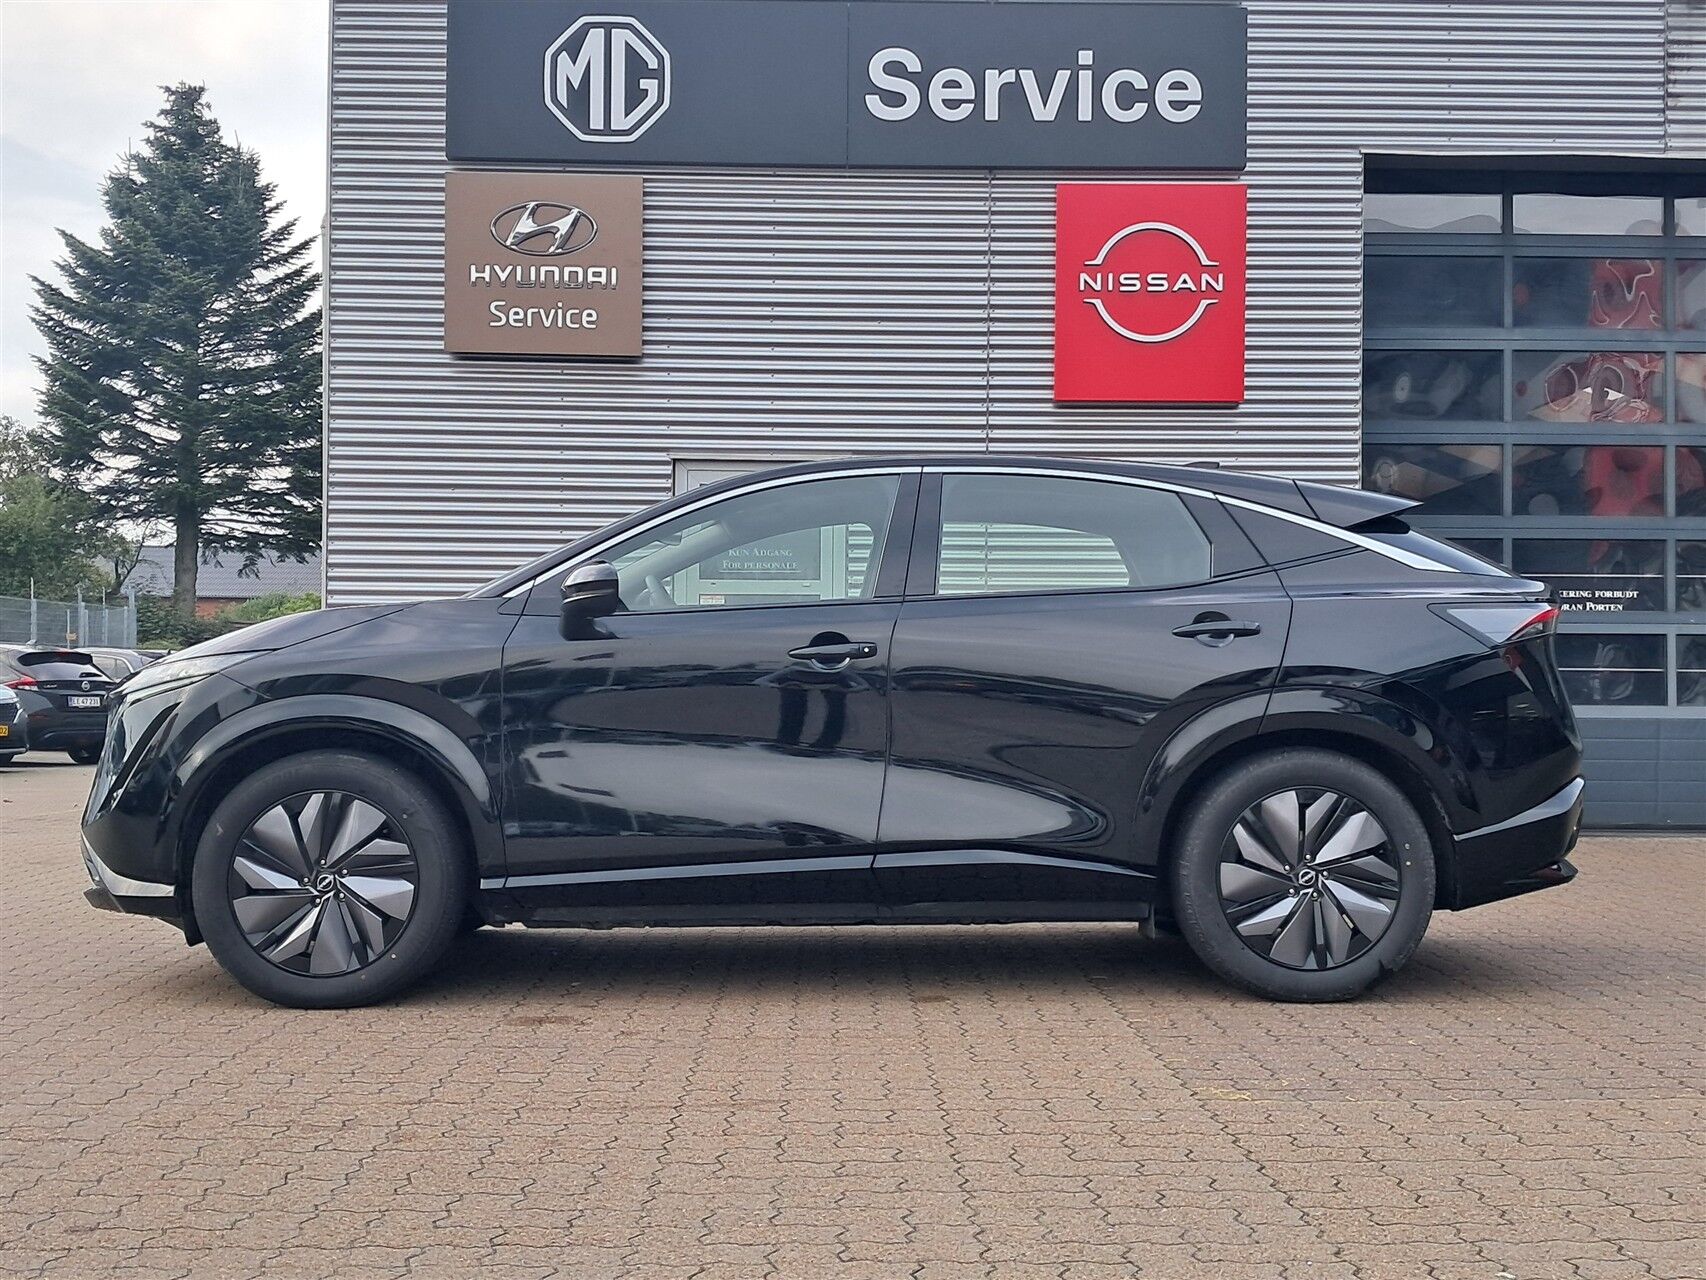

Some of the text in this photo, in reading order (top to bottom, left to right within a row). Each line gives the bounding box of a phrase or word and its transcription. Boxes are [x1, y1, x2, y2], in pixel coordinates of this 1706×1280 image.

[556, 28, 659, 130] MG
[864, 47, 1204, 125] Service
[469, 264, 618, 290] HYUNDAI
[1078, 271, 1224, 294] NISSAN
[488, 300, 599, 329] Service
[1585, 602, 1623, 611] PORTEN
[1595, 590, 1639, 598] FORBUDT
